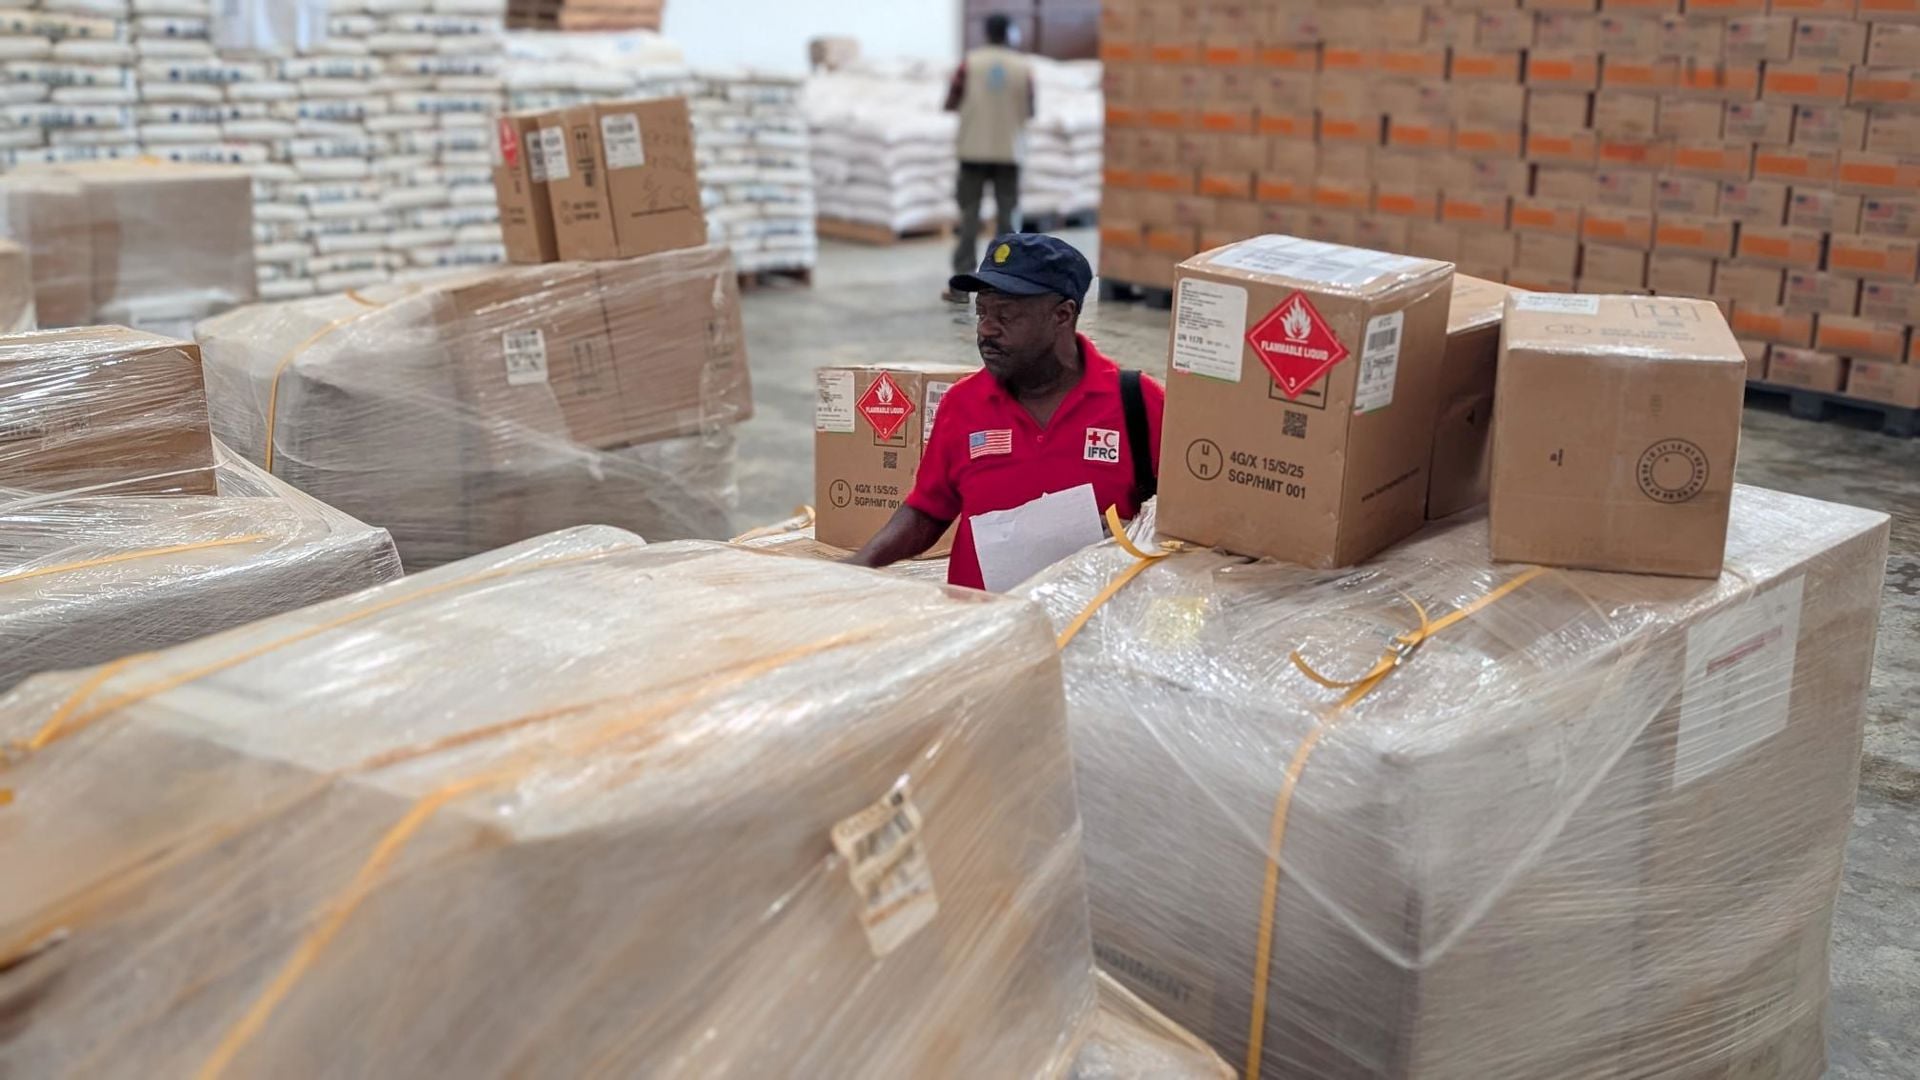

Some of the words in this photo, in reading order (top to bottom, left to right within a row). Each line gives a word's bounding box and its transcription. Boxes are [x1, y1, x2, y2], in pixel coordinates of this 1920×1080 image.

[1261, 340, 1303, 357] FLAMMABLE
[1303, 347, 1329, 361] LIQUID
[1289, 377, 1295, 388] 3
[1088, 446, 1117, 460] IFRC
[1230, 451, 1258, 468] 4G/X
[1262, 457, 1305, 478] 15/S/25
[854, 484, 871, 494] 4G/X
[873, 484, 899, 496] 15/S/25
[1228, 468, 1284, 493] SGP/HMT
[1285, 483, 1306, 499] 001
[887, 499, 900, 509] 001
